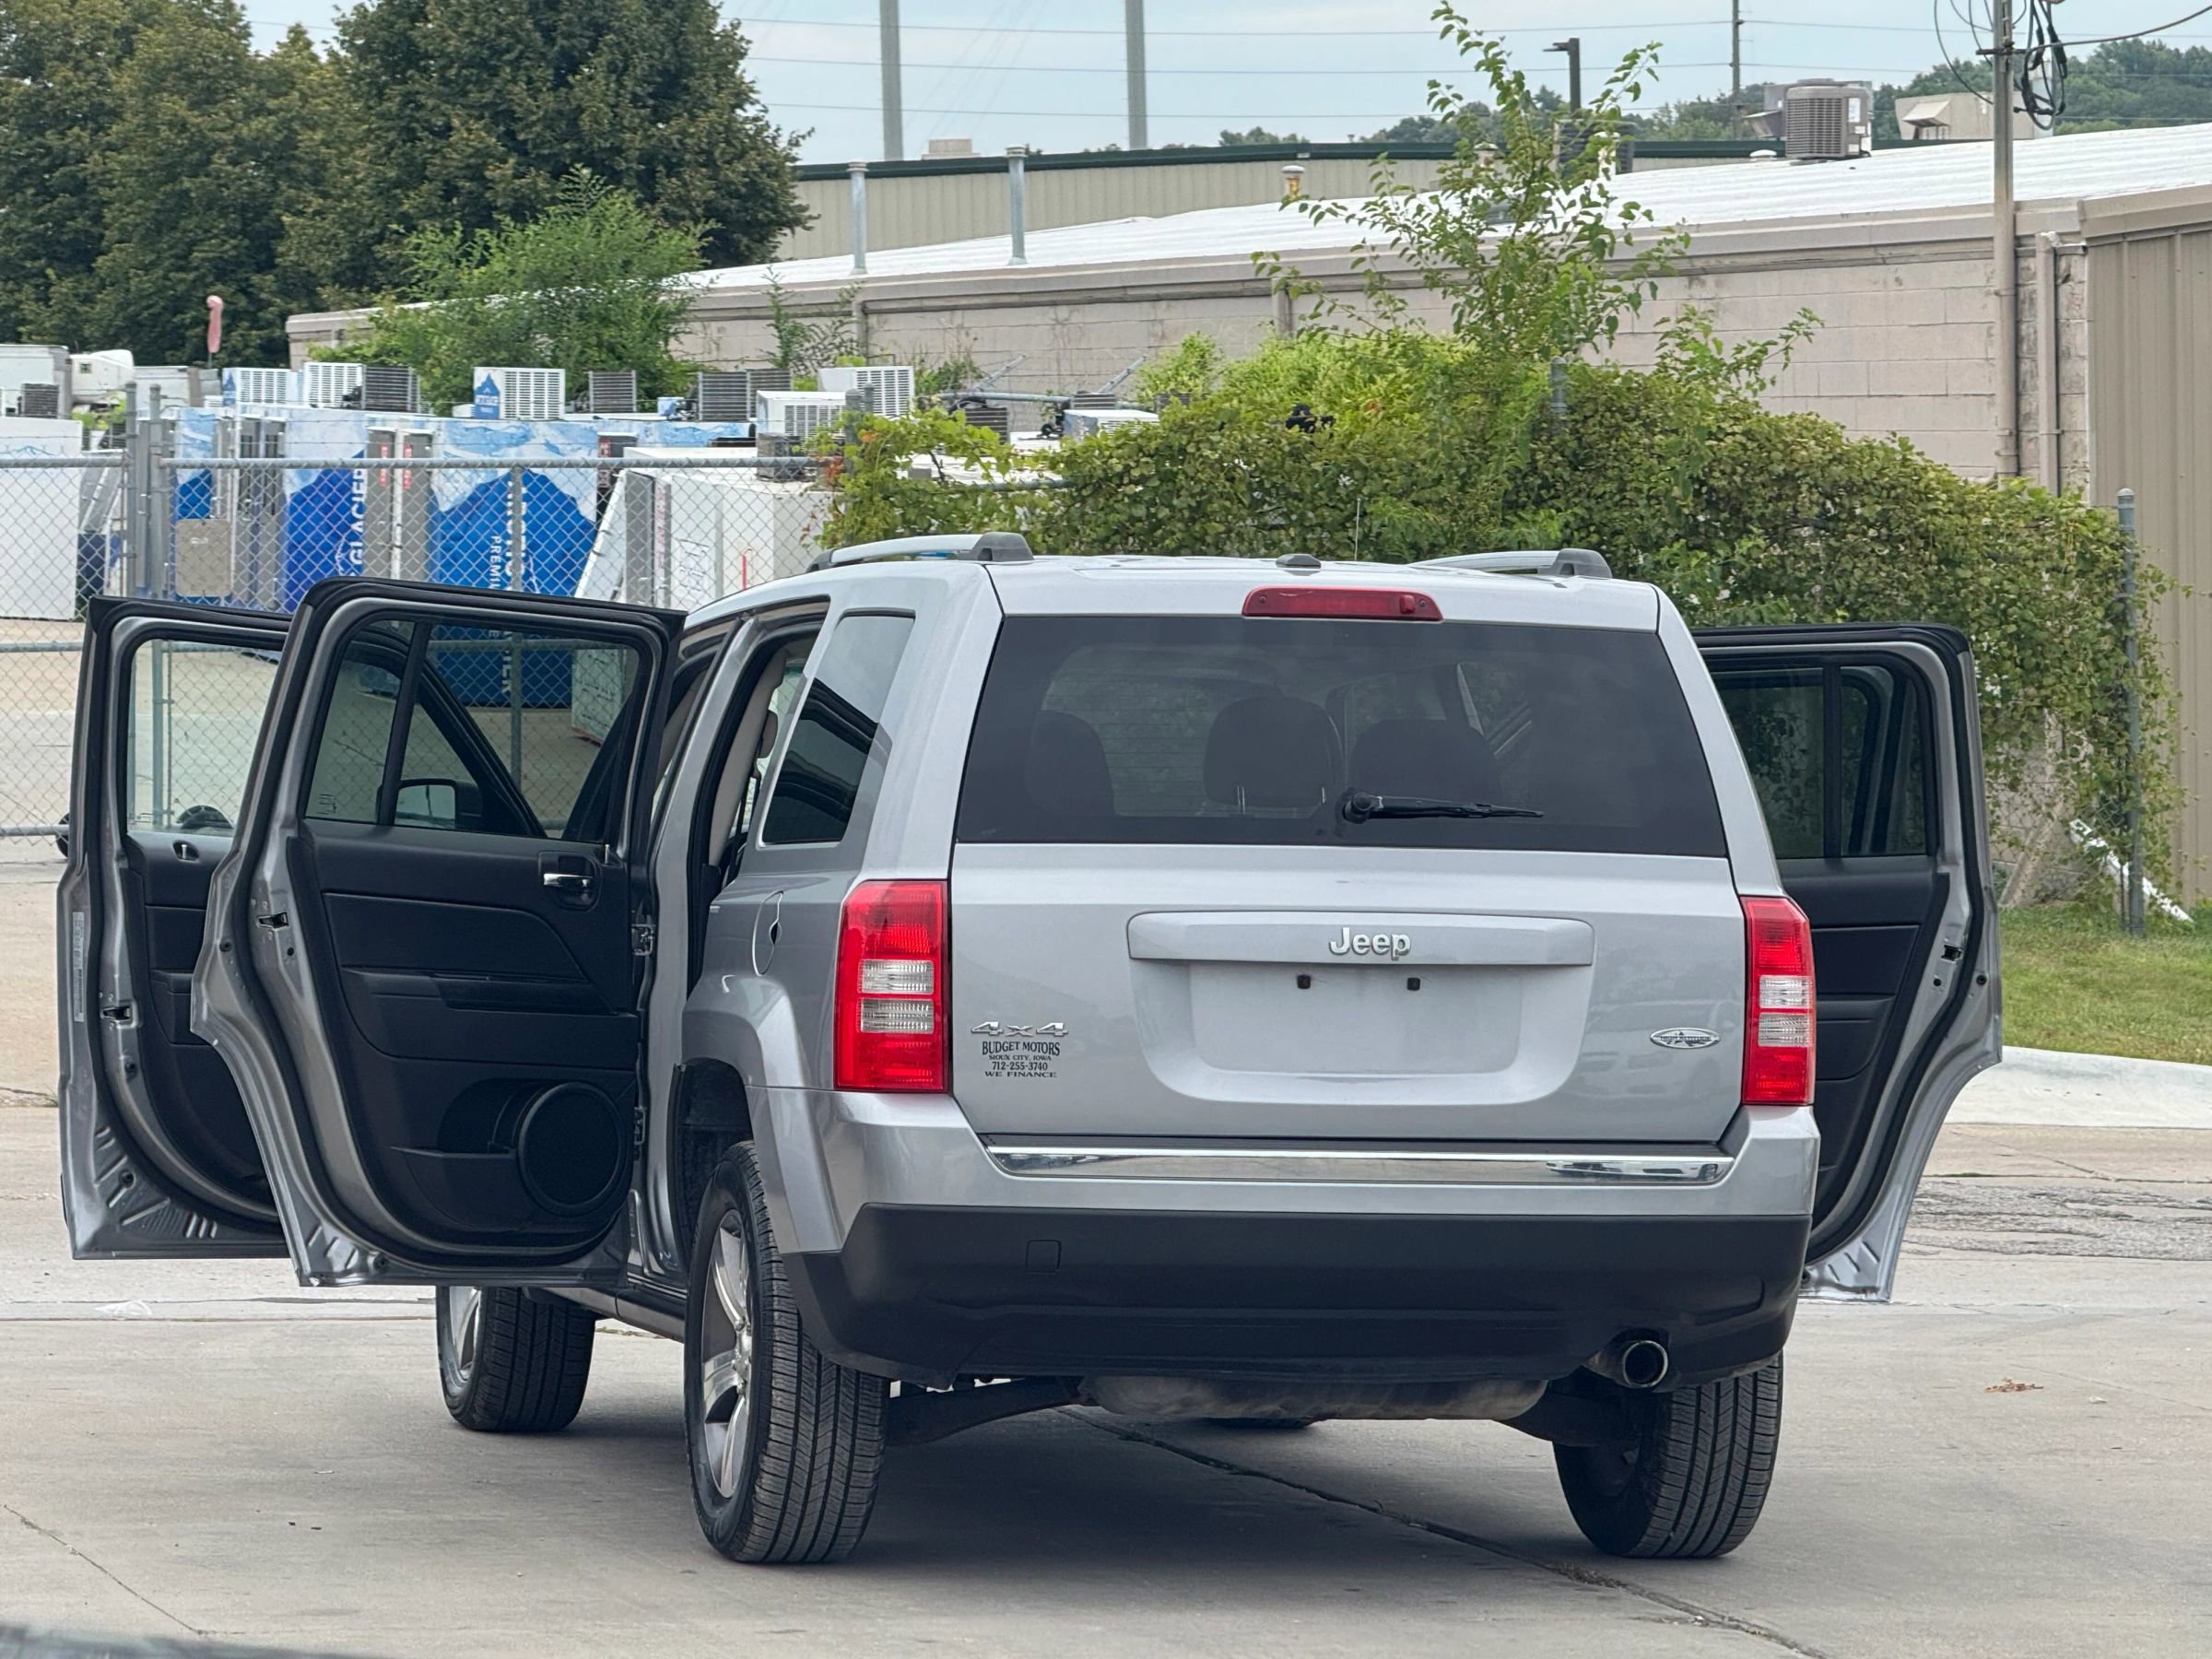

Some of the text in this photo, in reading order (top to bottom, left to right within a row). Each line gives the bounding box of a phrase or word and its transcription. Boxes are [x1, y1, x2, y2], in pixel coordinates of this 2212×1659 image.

[1329, 927, 1411, 960] Jeep
[982, 1041, 1061, 1056] BUDGET MOTORS
[992, 1061, 1049, 1071] 712-255-3740
